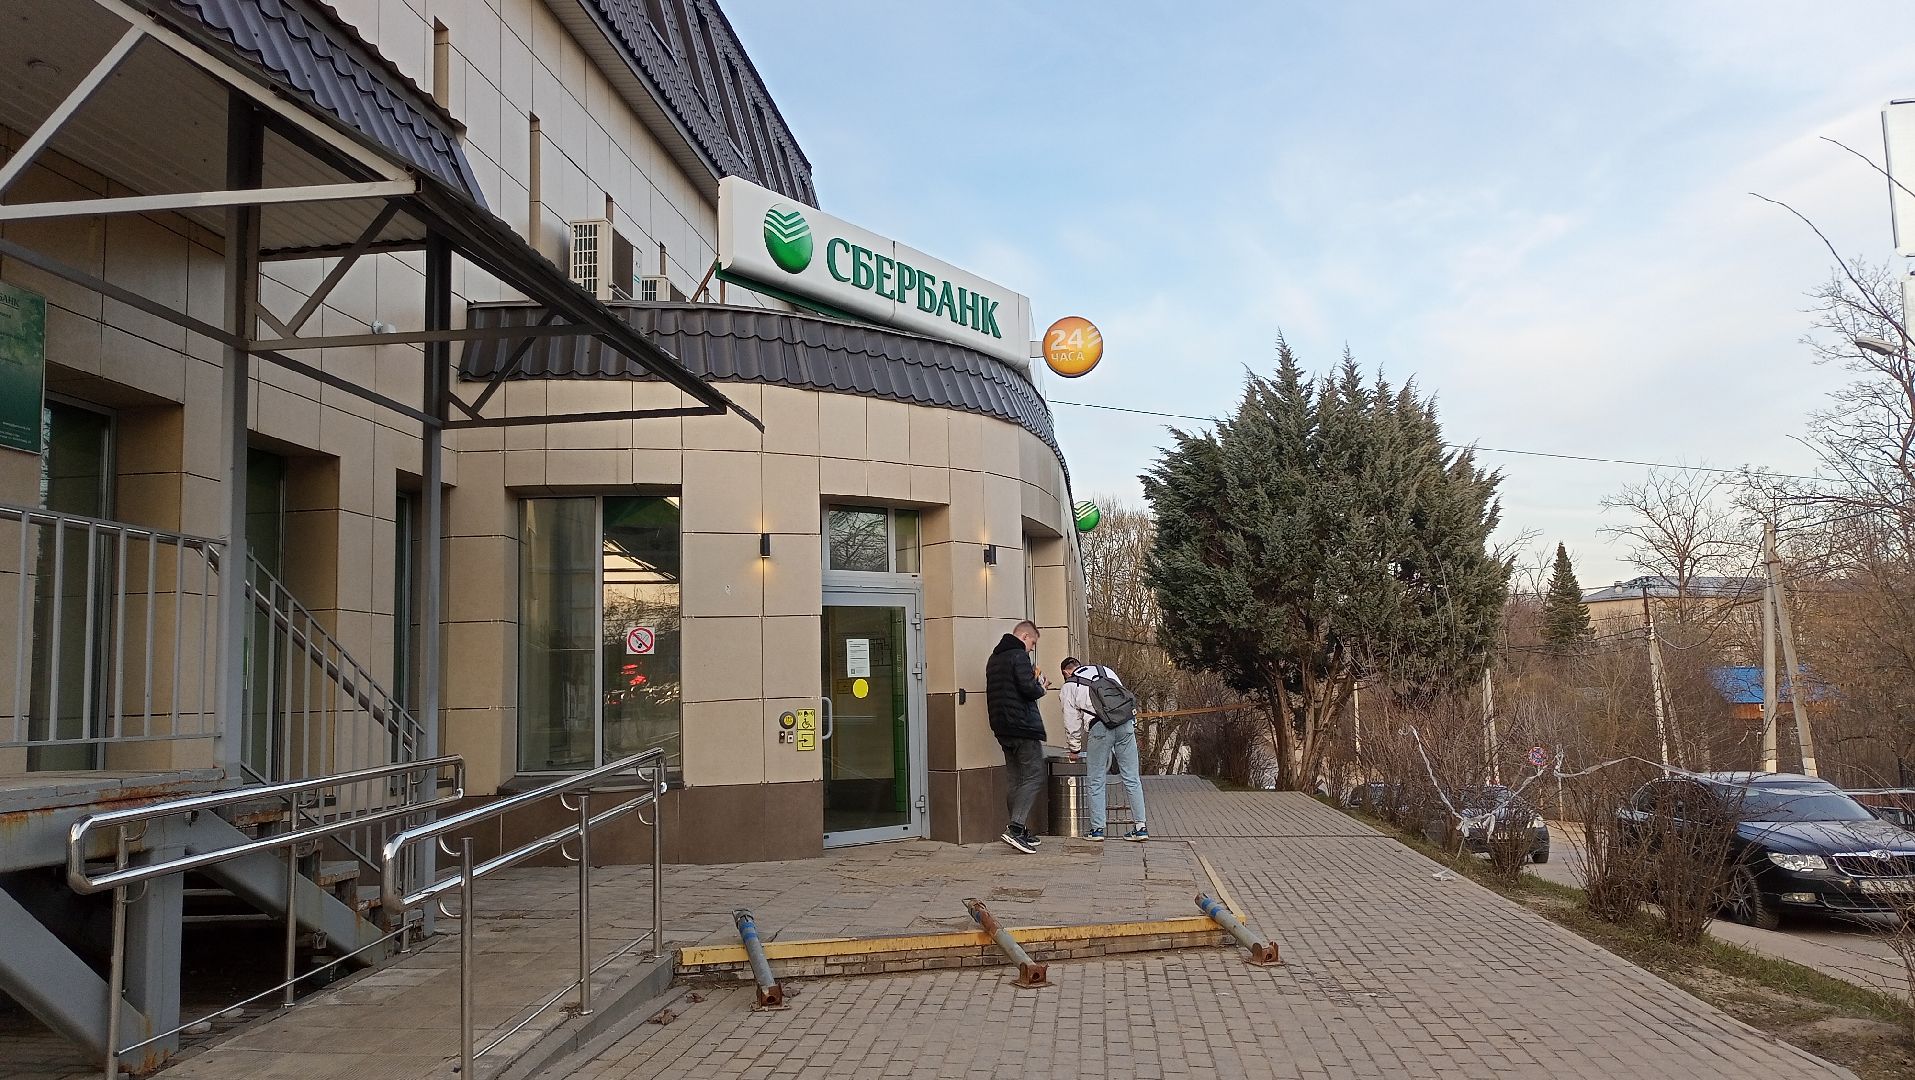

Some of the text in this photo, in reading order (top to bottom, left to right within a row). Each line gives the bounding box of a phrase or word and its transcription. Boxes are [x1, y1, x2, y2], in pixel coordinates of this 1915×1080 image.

[827, 237, 1001, 338] СБЕРБАНК
[1050, 328, 1084, 351] 24
[1051, 351, 1084, 362] ЧАСА
